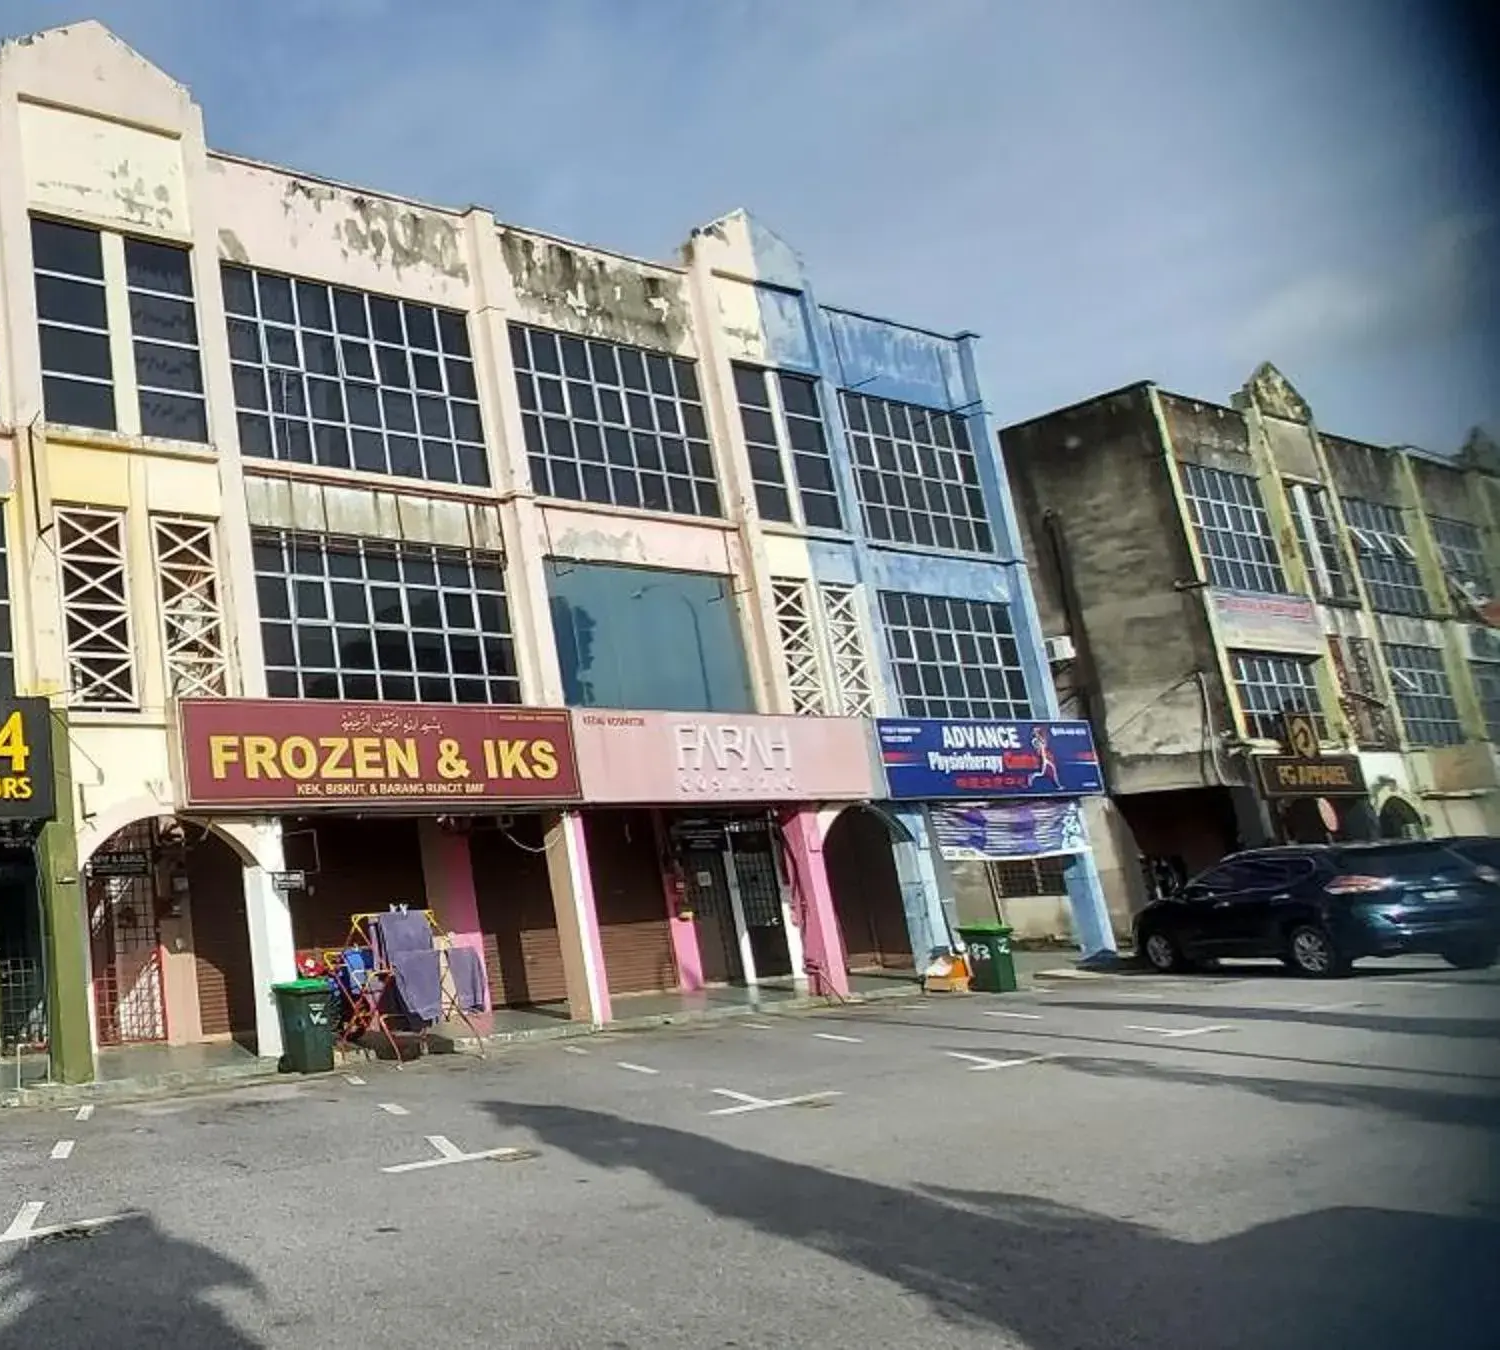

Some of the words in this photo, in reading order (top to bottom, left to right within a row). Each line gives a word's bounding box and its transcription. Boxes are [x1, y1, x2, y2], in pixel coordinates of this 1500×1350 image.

[676, 724, 793, 770] FARAH
[941, 726, 1021, 749] ADVANCE
[209, 735, 419, 780] FROZEN
[436, 738, 471, 779] &
[484, 738, 560, 780] IKS
[927, 751, 1003, 774] Physiotherapy
[380, 783, 425, 795] BARANG
